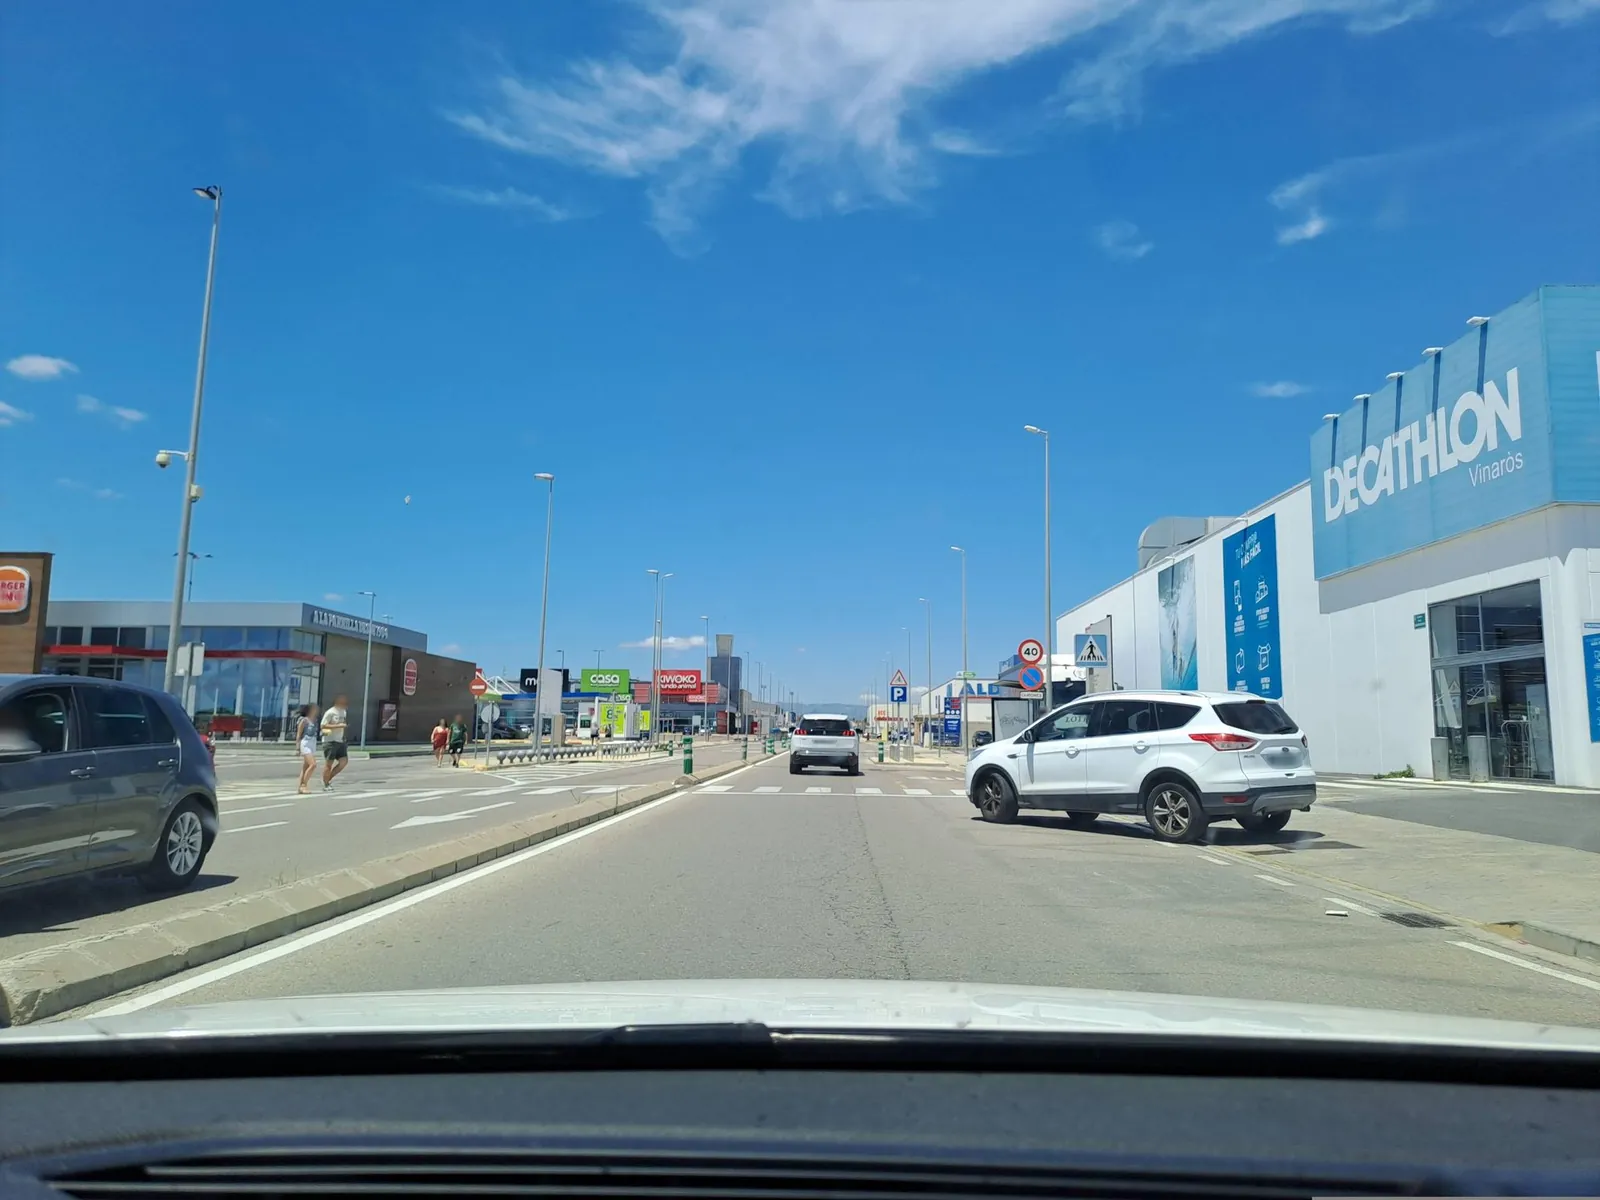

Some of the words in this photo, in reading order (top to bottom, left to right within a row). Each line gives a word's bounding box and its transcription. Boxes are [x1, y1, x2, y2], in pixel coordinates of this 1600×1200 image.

[1324, 367, 1521, 522] DECATHLON
[1469, 450, 1523, 487] Vinaròs
[1023, 648, 1038, 656] 40
[590, 674, 620, 684] casa
[894, 688, 904, 700] P
